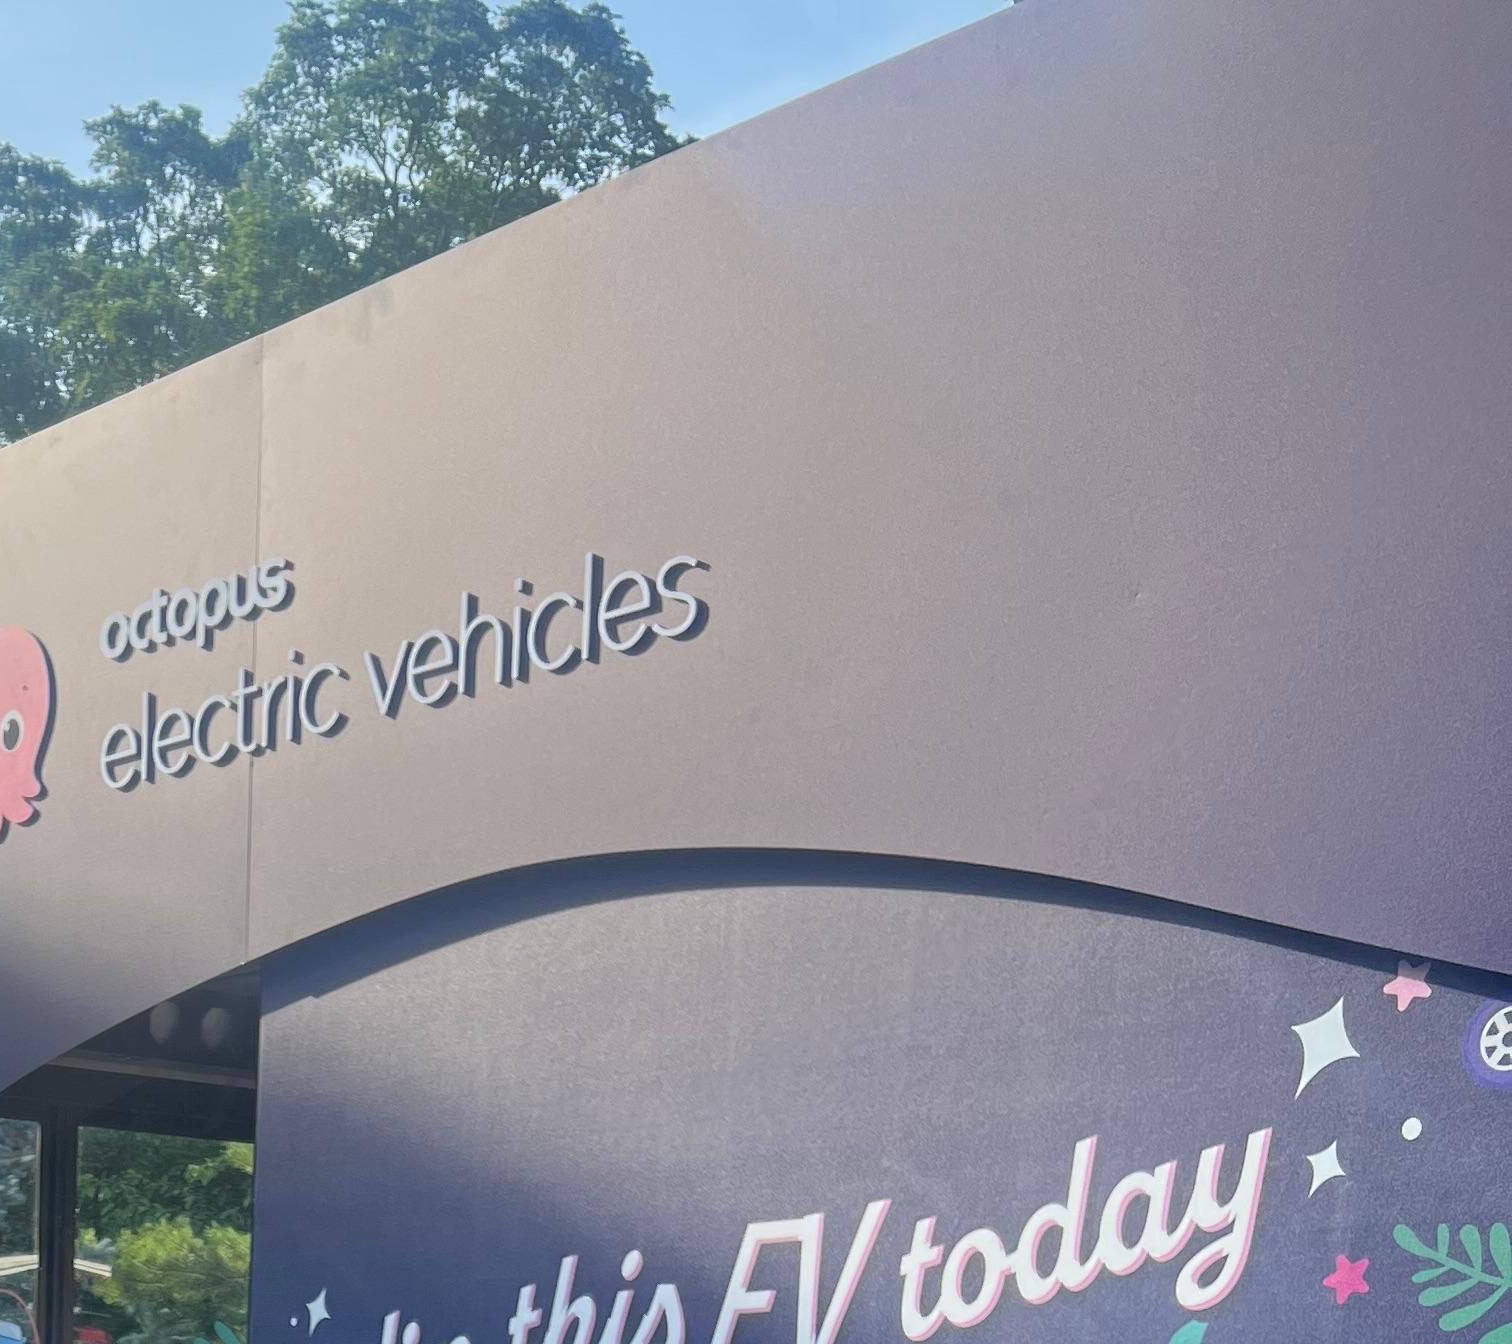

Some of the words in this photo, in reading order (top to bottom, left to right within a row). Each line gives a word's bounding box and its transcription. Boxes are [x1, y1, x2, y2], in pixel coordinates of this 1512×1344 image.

[99, 556, 292, 659] octopus
[99, 649, 343, 789] electric
[362, 551, 702, 716] vehicles
[899, 1127, 1273, 1342] today
